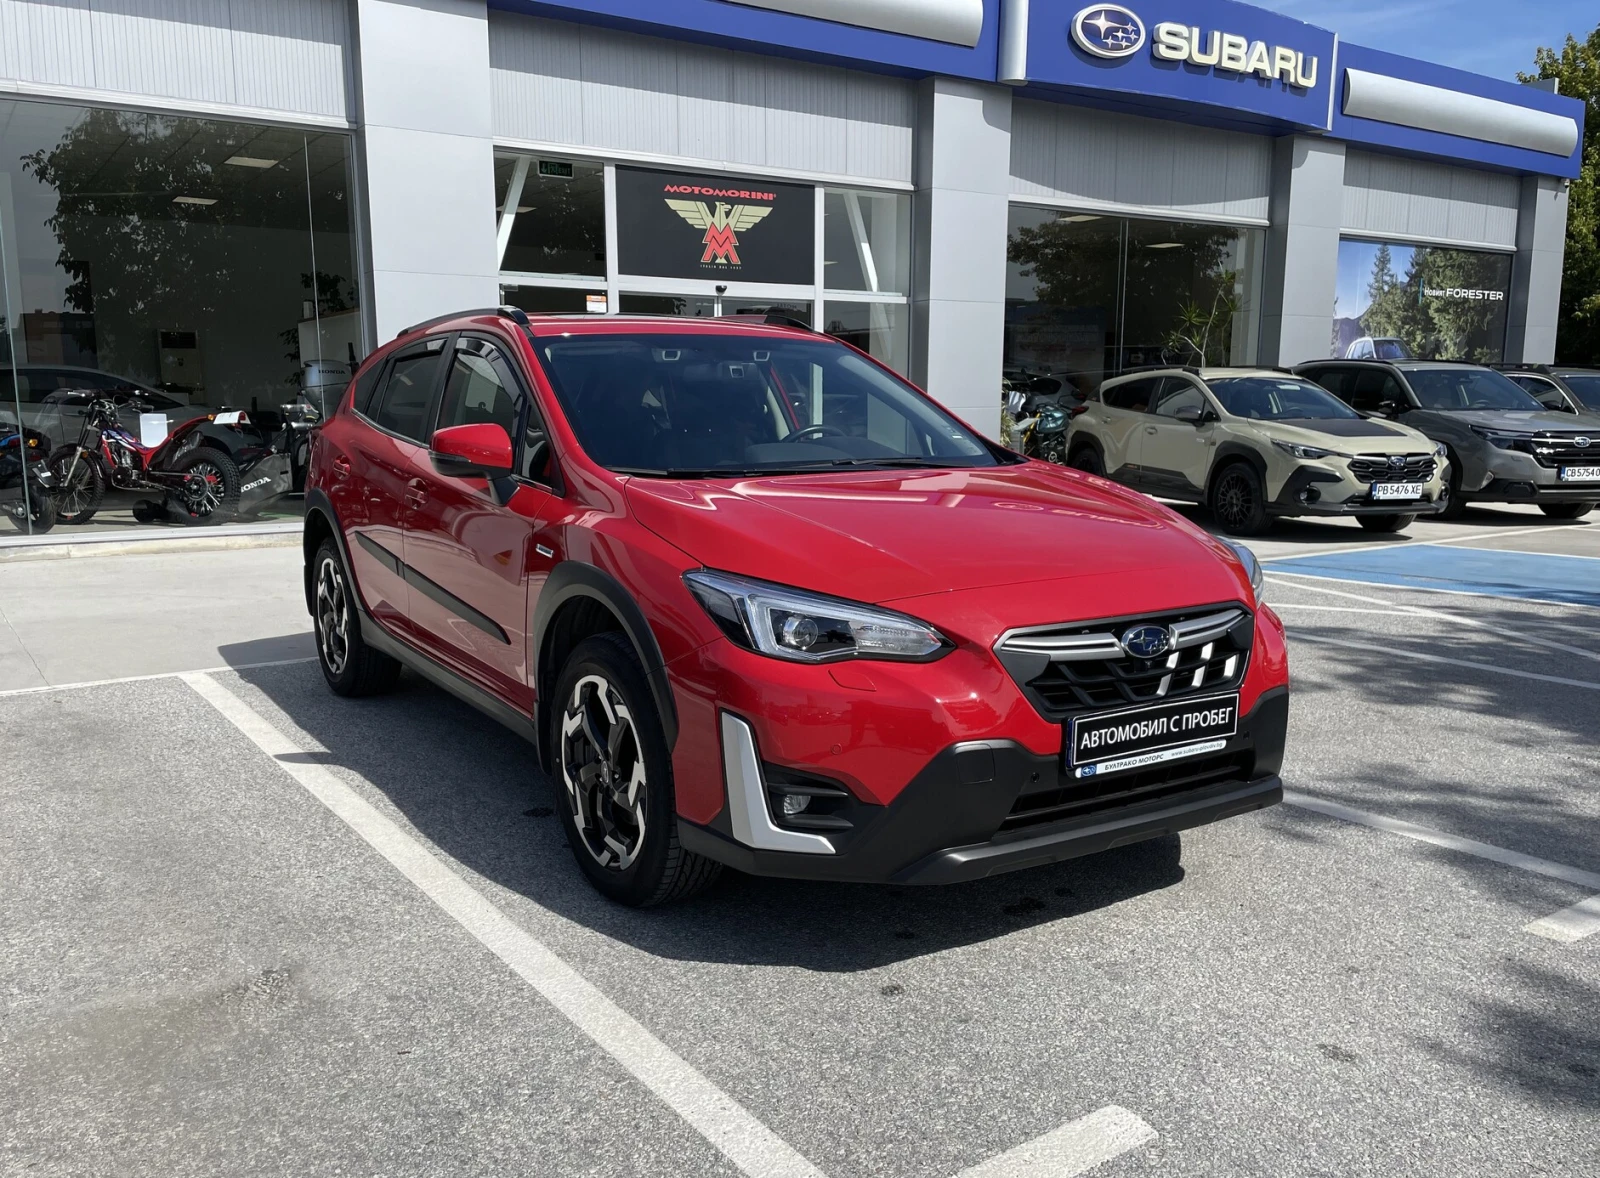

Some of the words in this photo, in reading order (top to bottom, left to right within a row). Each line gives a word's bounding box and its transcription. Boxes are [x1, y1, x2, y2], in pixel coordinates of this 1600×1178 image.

[1153, 22, 1318, 89] SUBARU
[1446, 288, 1504, 301] FORESTER
[1390, 485, 1409, 495] 5476
[1080, 718, 1167, 749] АВТОМОБИЛ
[1170, 715, 1180, 732] С
[1182, 707, 1233, 730] ПРОБЕГ
[1104, 758, 1138, 771] БУЛТРАКО
[1138, 753, 1164, 765] МОТОРС
